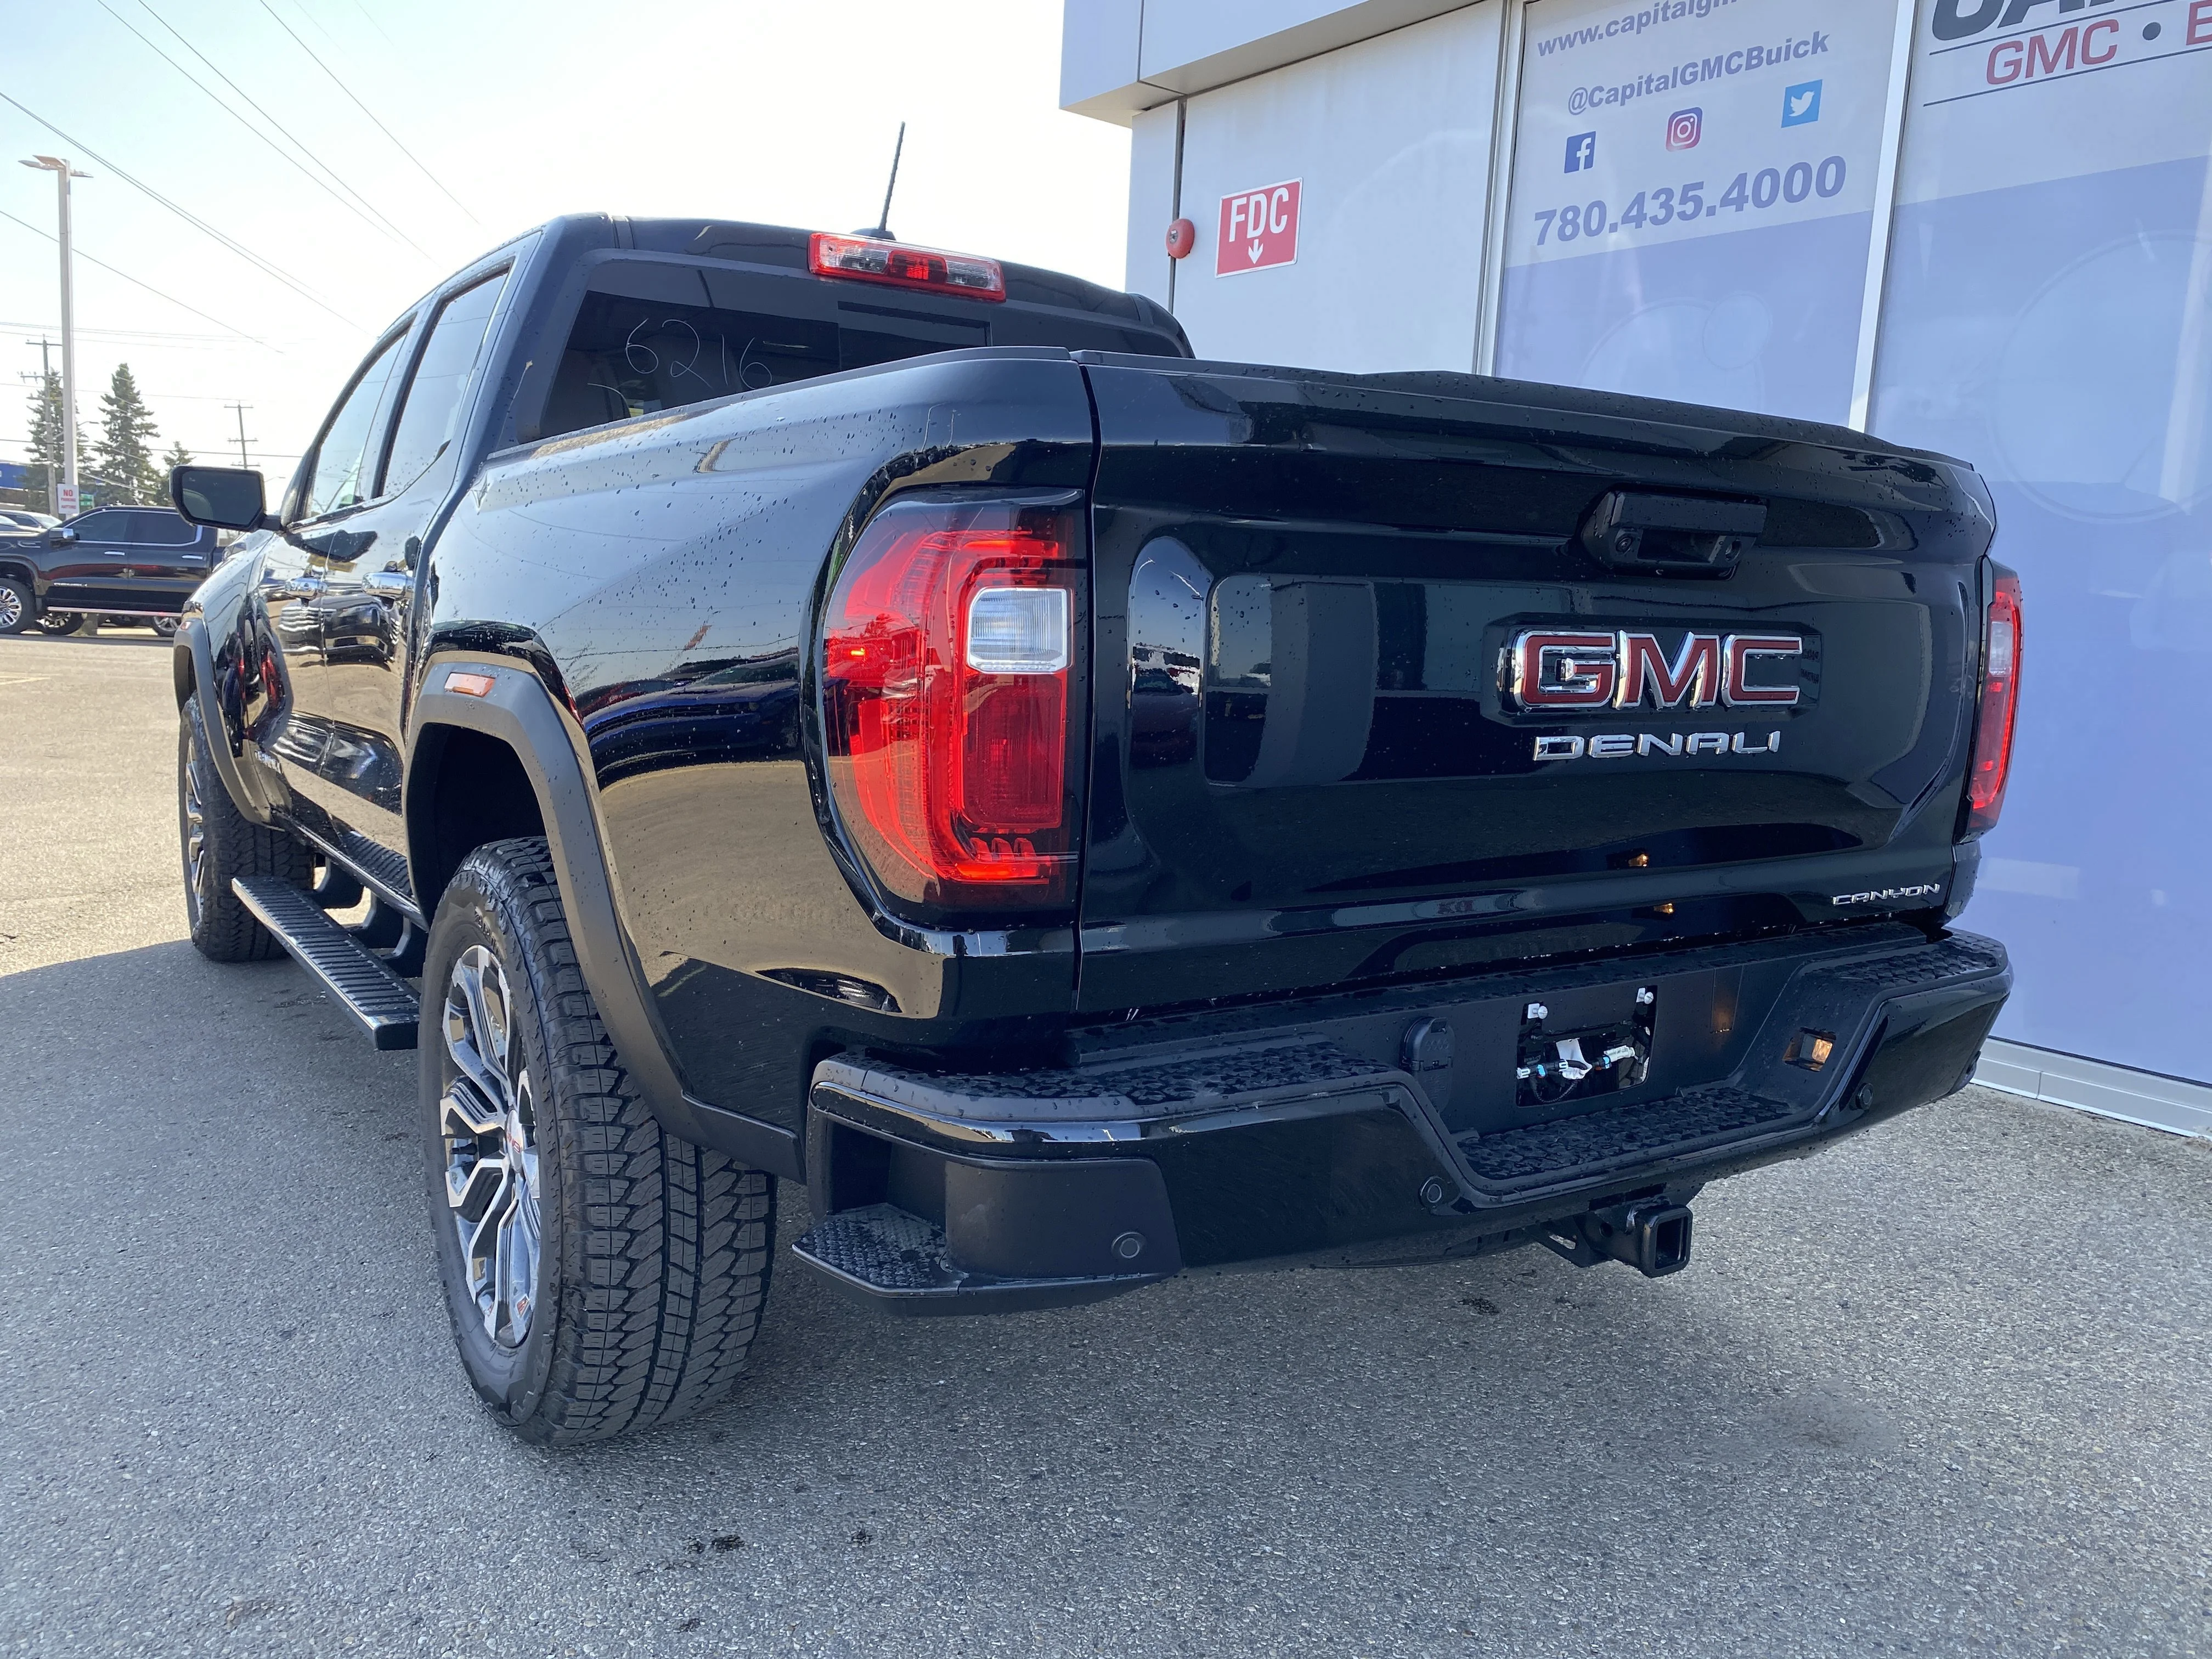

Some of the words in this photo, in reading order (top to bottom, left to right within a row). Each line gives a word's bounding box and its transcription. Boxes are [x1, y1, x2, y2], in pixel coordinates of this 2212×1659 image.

[1568, 31, 1830, 116] @CapitalGMCBuick
[1986, 19, 2119, 85] GMC
[1229, 187, 1289, 242] FDC
[1534, 155, 1846, 246] 780.435.4000
[625, 317, 772, 390] 6216
[1512, 629, 1803, 711] GMC
[1532, 730, 1781, 761] DENALI
[1831, 883, 1940, 905] CANYON
